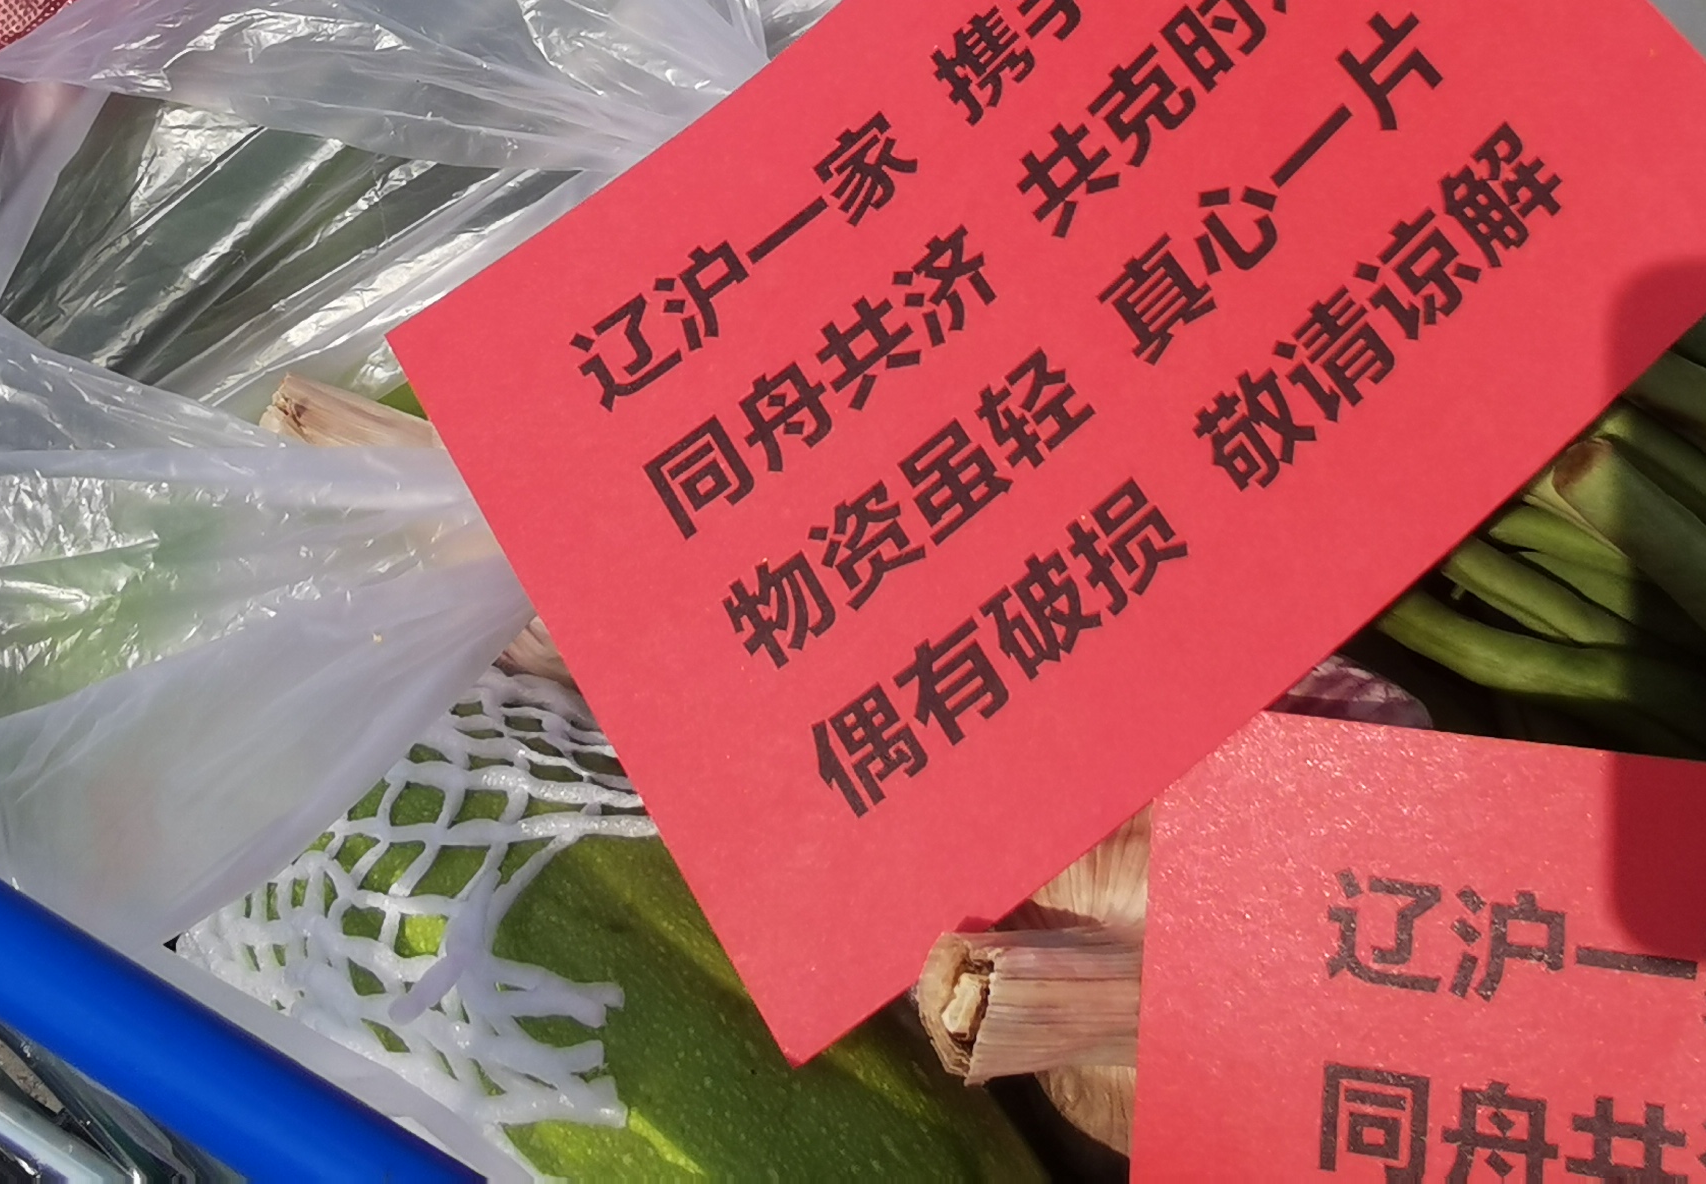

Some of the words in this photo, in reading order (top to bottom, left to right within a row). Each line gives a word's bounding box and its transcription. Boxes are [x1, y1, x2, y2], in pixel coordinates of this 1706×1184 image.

[570, 115, 917, 411] 辽沪一家
[644, 226, 996, 539] 同舟共济
[724, 349, 1095, 663] 物资虽轻
[1099, 14, 1443, 365] 真心一片
[812, 484, 1188, 818] 偶有破损
[1194, 129, 1562, 491] 敬请谅解
